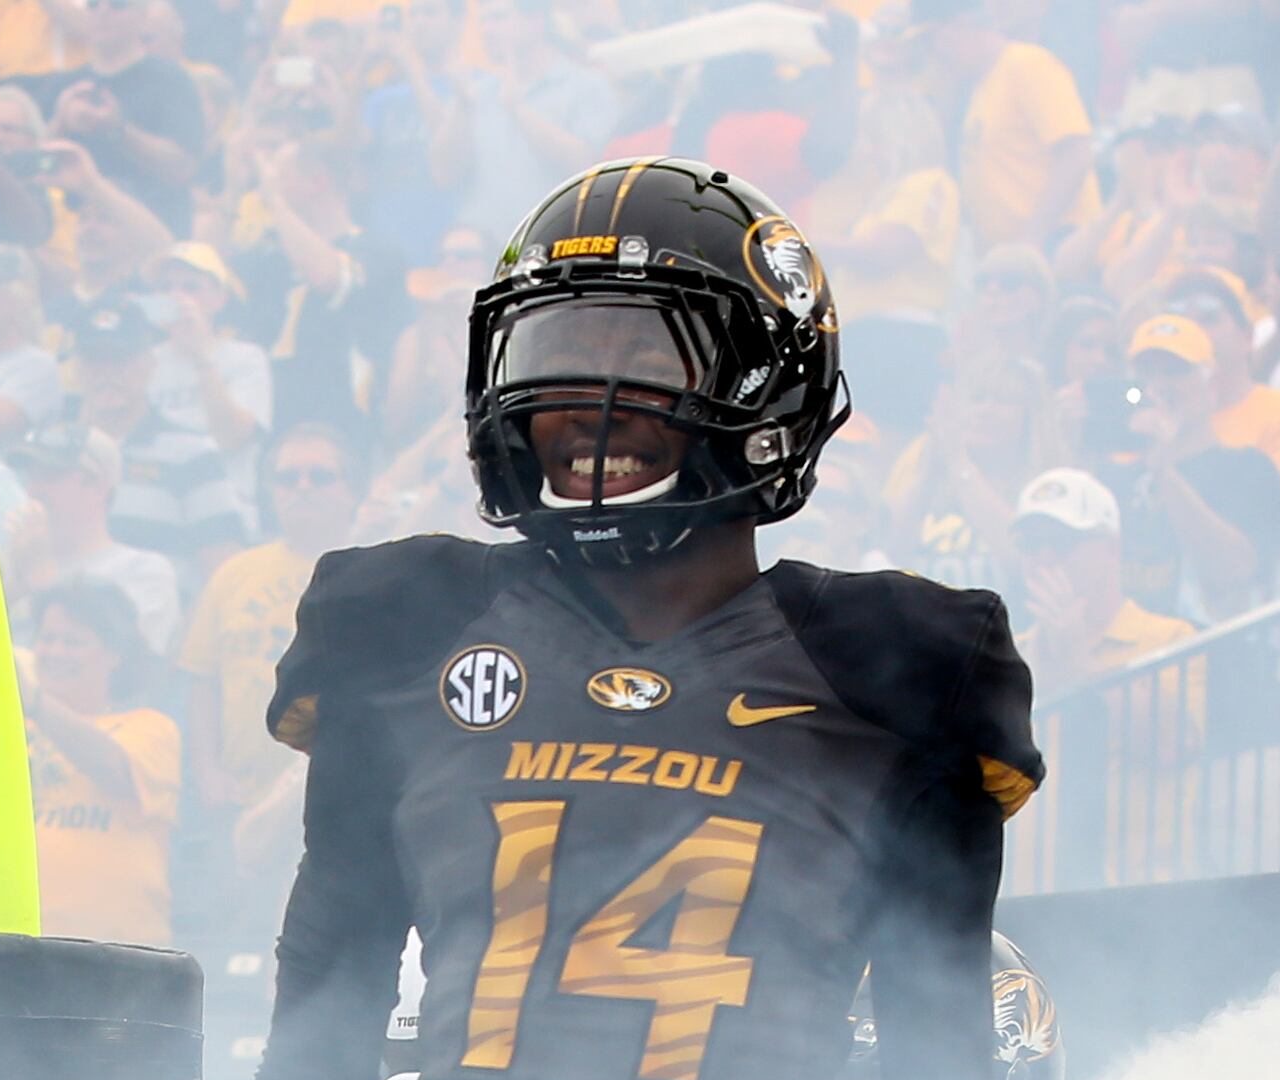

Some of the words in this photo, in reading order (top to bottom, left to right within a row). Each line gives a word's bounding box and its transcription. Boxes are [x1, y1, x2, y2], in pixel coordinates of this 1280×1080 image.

[551, 235, 618, 259] TIGERS
[449, 649, 520, 726] SEC
[504, 742, 743, 797] MIZZOU
